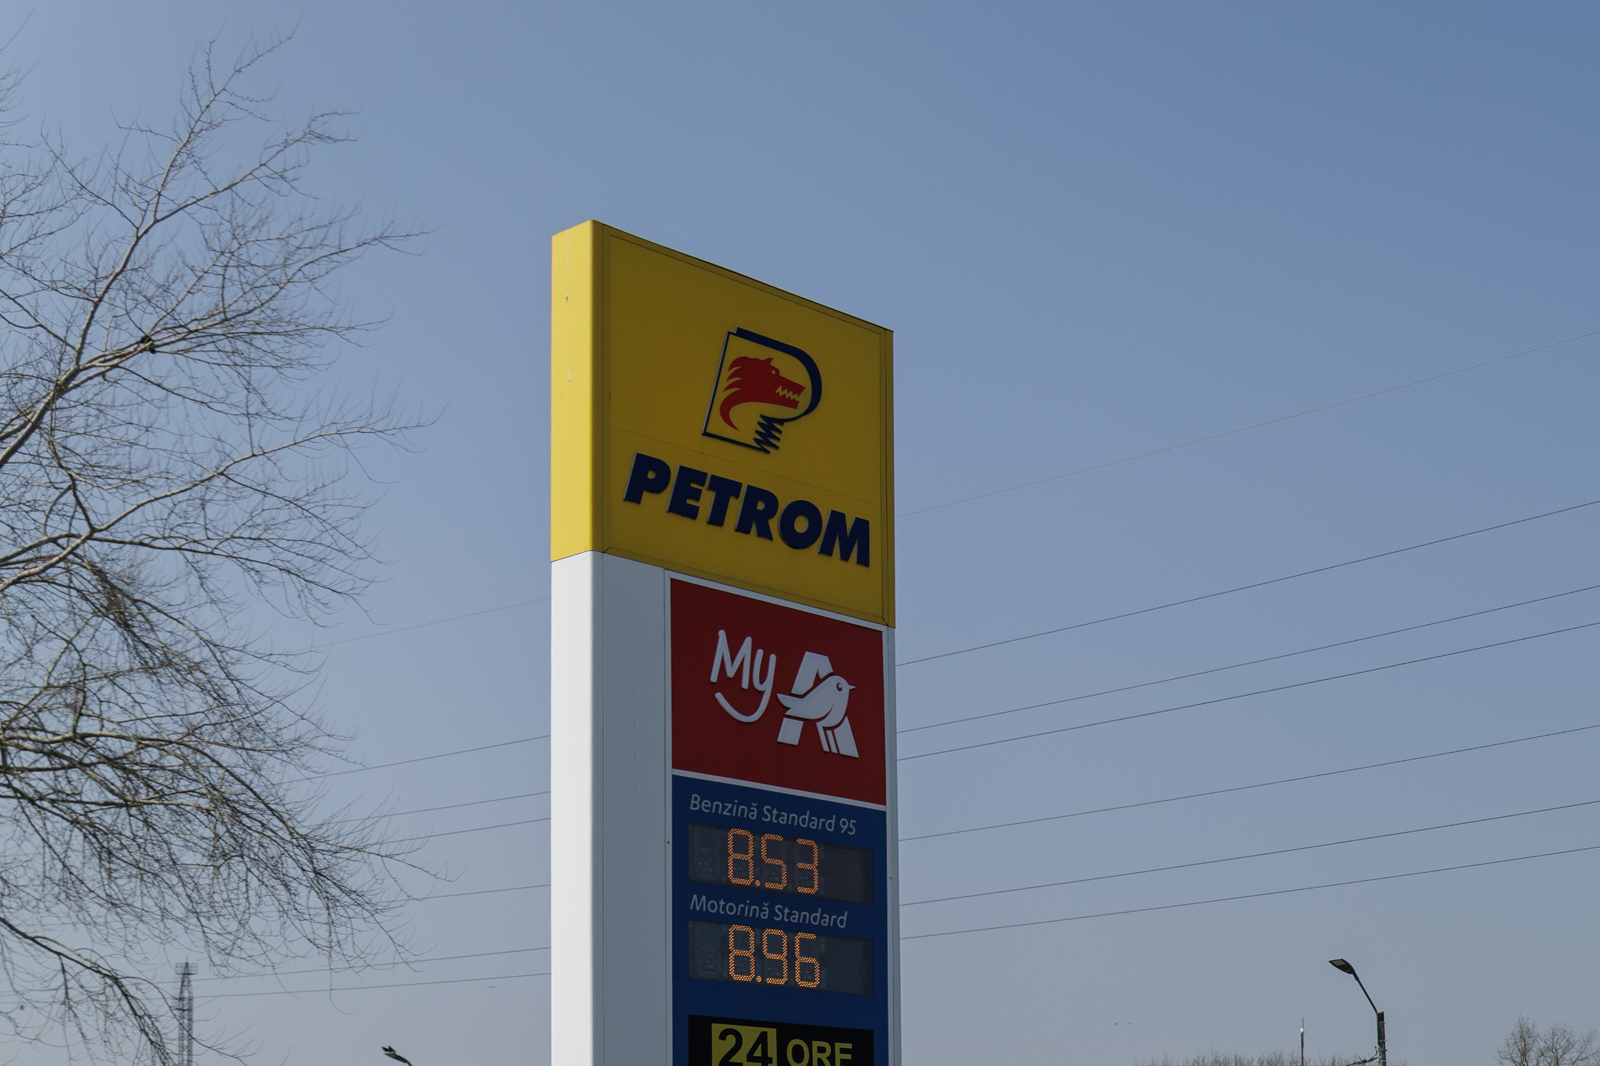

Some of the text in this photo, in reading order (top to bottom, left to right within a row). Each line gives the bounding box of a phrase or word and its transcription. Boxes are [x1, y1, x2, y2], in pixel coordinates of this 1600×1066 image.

[622, 452, 870, 567] PETROM
[710, 629, 777, 723] My
[689, 793, 857, 836] Benzină Standard 95
[727, 828, 820, 895] 8.53
[689, 894, 848, 929] Motorină Standard
[728, 924, 821, 988] 8.96
